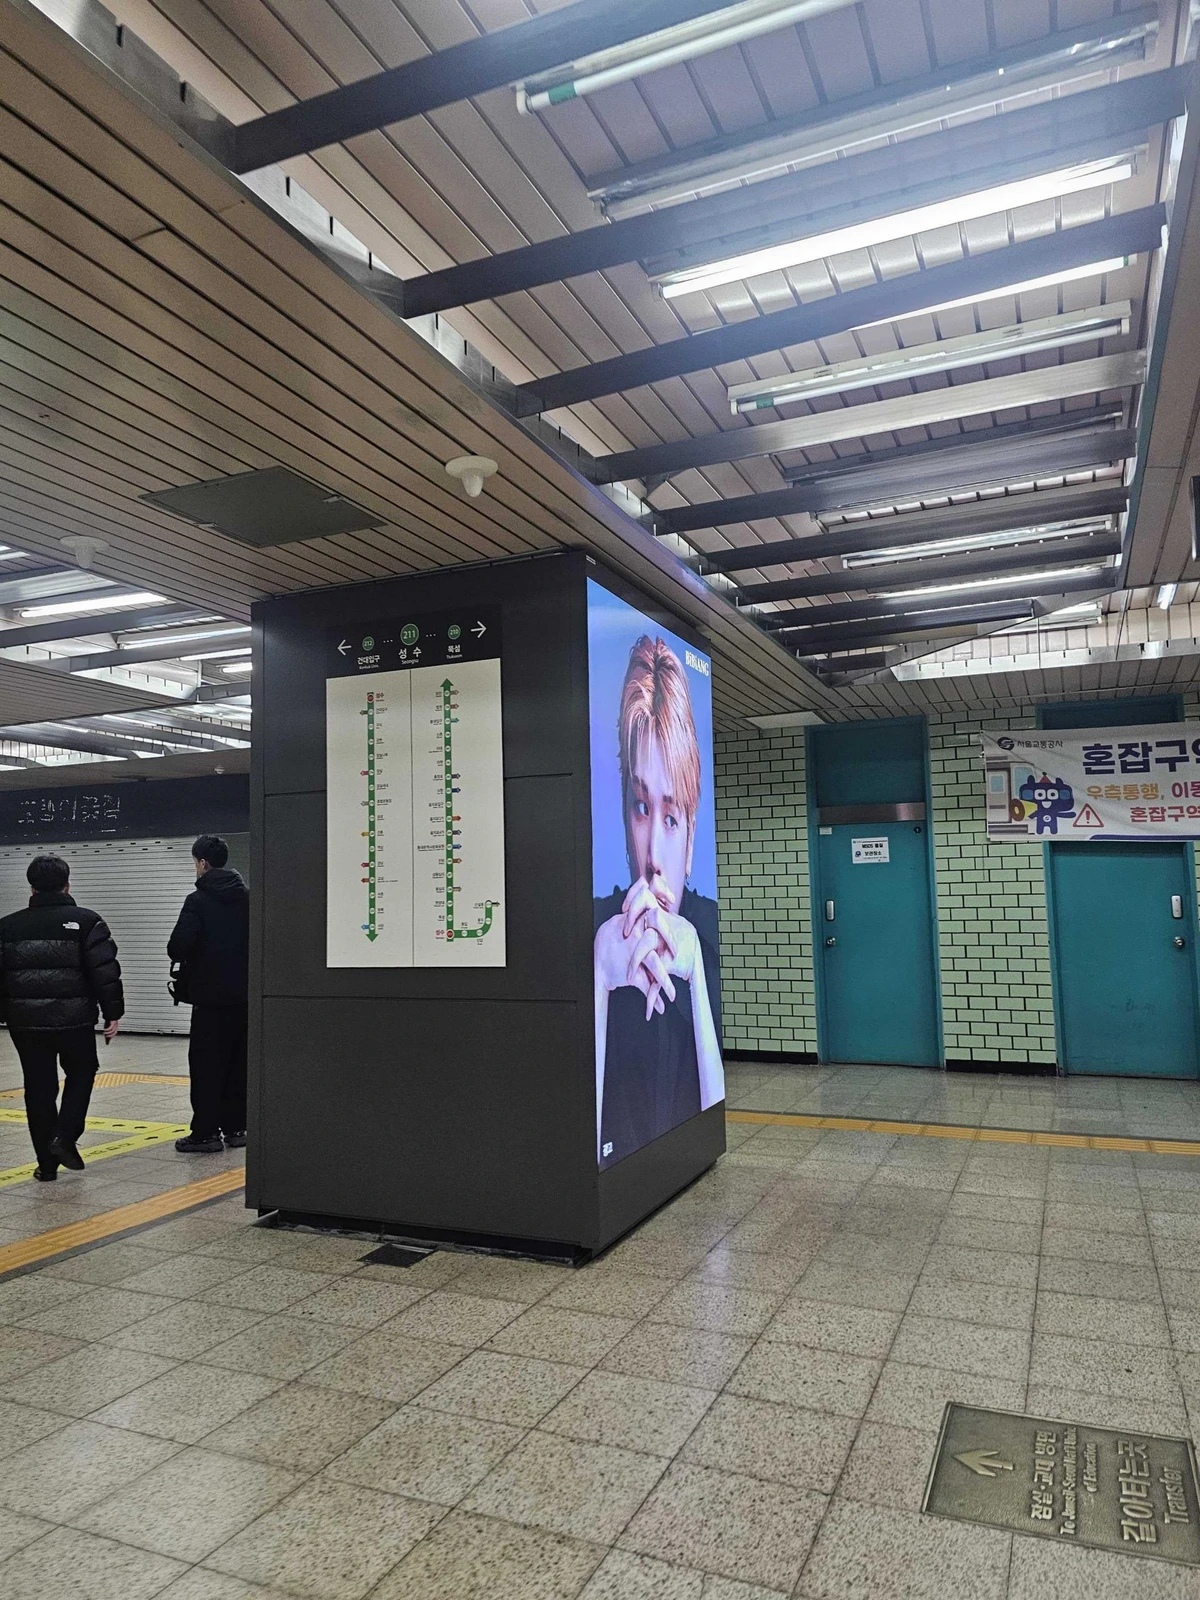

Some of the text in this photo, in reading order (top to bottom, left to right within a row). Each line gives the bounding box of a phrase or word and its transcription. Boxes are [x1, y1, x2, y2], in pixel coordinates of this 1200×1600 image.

[357, 655, 381, 664] 건대입구
[1016, 740, 1064, 750] 서울교통공사
[1082, 738, 1200, 775] 혼잡구
[1086, 782, 1165, 801] 우측통행,
[1035, 1430, 1057, 1456] 방면
[1083, 1443, 1098, 1493] of Education
[1117, 1440, 1157, 1543] 갈아타는곳
[1159, 1466, 1189, 1524] Transfer
[1060, 1521, 1075, 1535] To
